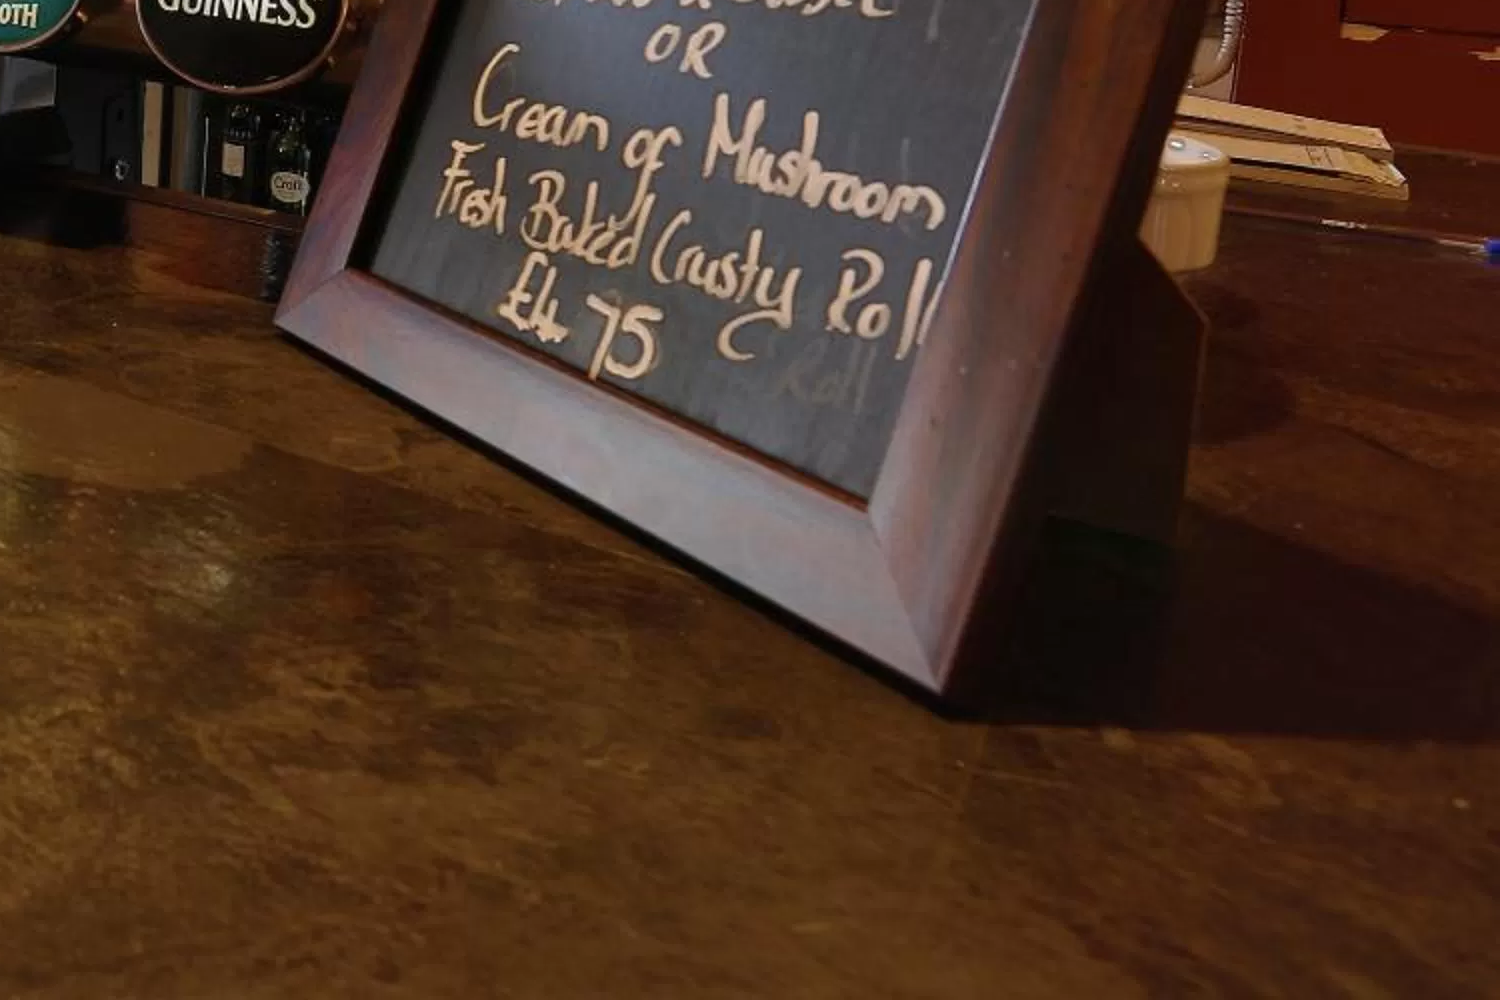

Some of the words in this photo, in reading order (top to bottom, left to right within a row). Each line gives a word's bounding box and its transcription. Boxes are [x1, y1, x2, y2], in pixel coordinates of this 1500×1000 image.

[471, 42, 612, 152] Cream
[610, 124, 684, 230] of
[702, 92, 948, 232] Mushroom
[644, 22, 729, 80] OR
[435, 138, 509, 236] Fresh
[519, 168, 656, 270] Baked
[649, 209, 803, 362] Crusty
[824, 247, 946, 361] Roll
